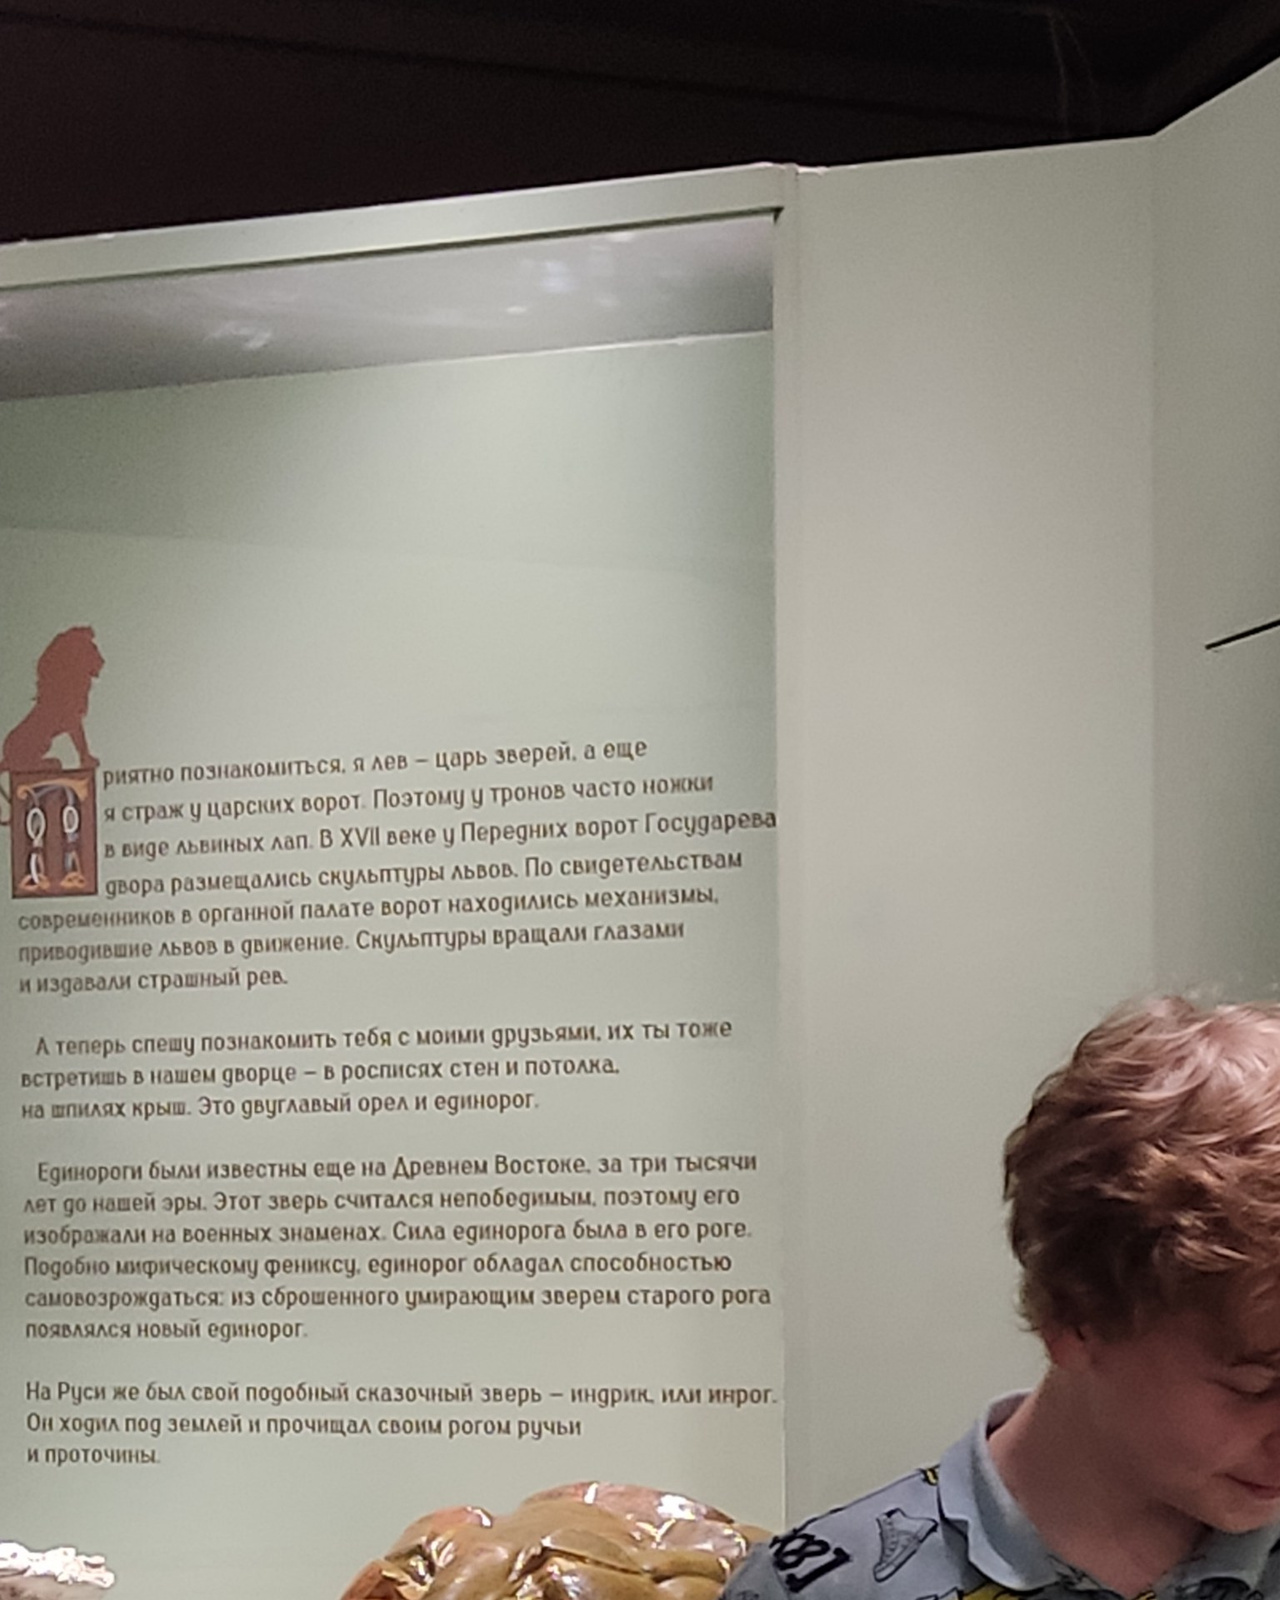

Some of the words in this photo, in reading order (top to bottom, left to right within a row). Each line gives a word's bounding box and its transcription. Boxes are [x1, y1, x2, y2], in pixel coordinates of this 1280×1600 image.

[352, 756, 366, 773] я
[370, 754, 409, 773] лев
[435, 749, 489, 773] царь
[583, 743, 597, 761] а
[602, 740, 648, 762] еще
[103, 805, 116, 823] я
[120, 802, 185, 826] страж
[189, 801, 202, 824] у
[206, 796, 296, 821] царских
[300, 793, 369, 817] ворот.
[372, 787, 466, 812] Поэтому
[470, 786, 484, 811] у
[488, 783, 567, 809] тронов
[571, 779, 637, 799] часто
[642, 775, 714, 796] ножки
[103, 843, 117, 859] в
[121, 840, 170, 863] виде
[175, 835, 266, 856] львиных
[270, 831, 315, 852] лап.
[319, 827, 334, 850] В
[339, 824, 381, 849] XVII
[386, 827, 437, 847] веке
[441, 826, 456, 850] у
[460, 820, 569, 847] Передних
[574, 817, 640, 842] ворот
[644, 809, 779, 840] Государева
[104, 877, 166, 901] двора
[170, 870, 313, 898] размещались
[317, 864, 446, 892] скульптуры
[449, 861, 520, 882] львов.
[524, 855, 554, 879] По
[559, 851, 743, 881] свидетельствам
[18, 978, 32, 995] и
[36, 974, 132, 998] издавали
[137, 965, 241, 994] страшный
[246, 969, 289, 992] рев.
[37, 1161, 144, 1188] Единороги
[148, 1159, 202, 1181] были
[205, 1161, 308, 1180] известны
[312, 1160, 357, 1183] еще
[360, 1160, 387, 1178] на
[390, 1155, 489, 1182] Древнем
[597, 1156, 623, 1175] за
[628, 1156, 668, 1178] три
[672, 1154, 758, 1174] тысячи
[23, 1197, 58, 1214] лет
[62, 1196, 88, 1219] до
[92, 1190, 157, 1214] нашей
[161, 1195, 209, 1217] эры.
[211, 1190, 264, 1212] Этот
[266, 1193, 329, 1215] зверь
[333, 1191, 435, 1211] считался
[603, 1187, 698, 1212] поэтому
[702, 1187, 741, 1206] его
[25, 1322, 132, 1339] появлялся
[135, 1316, 202, 1339] новый
[206, 1321, 309, 1344] единорог.
